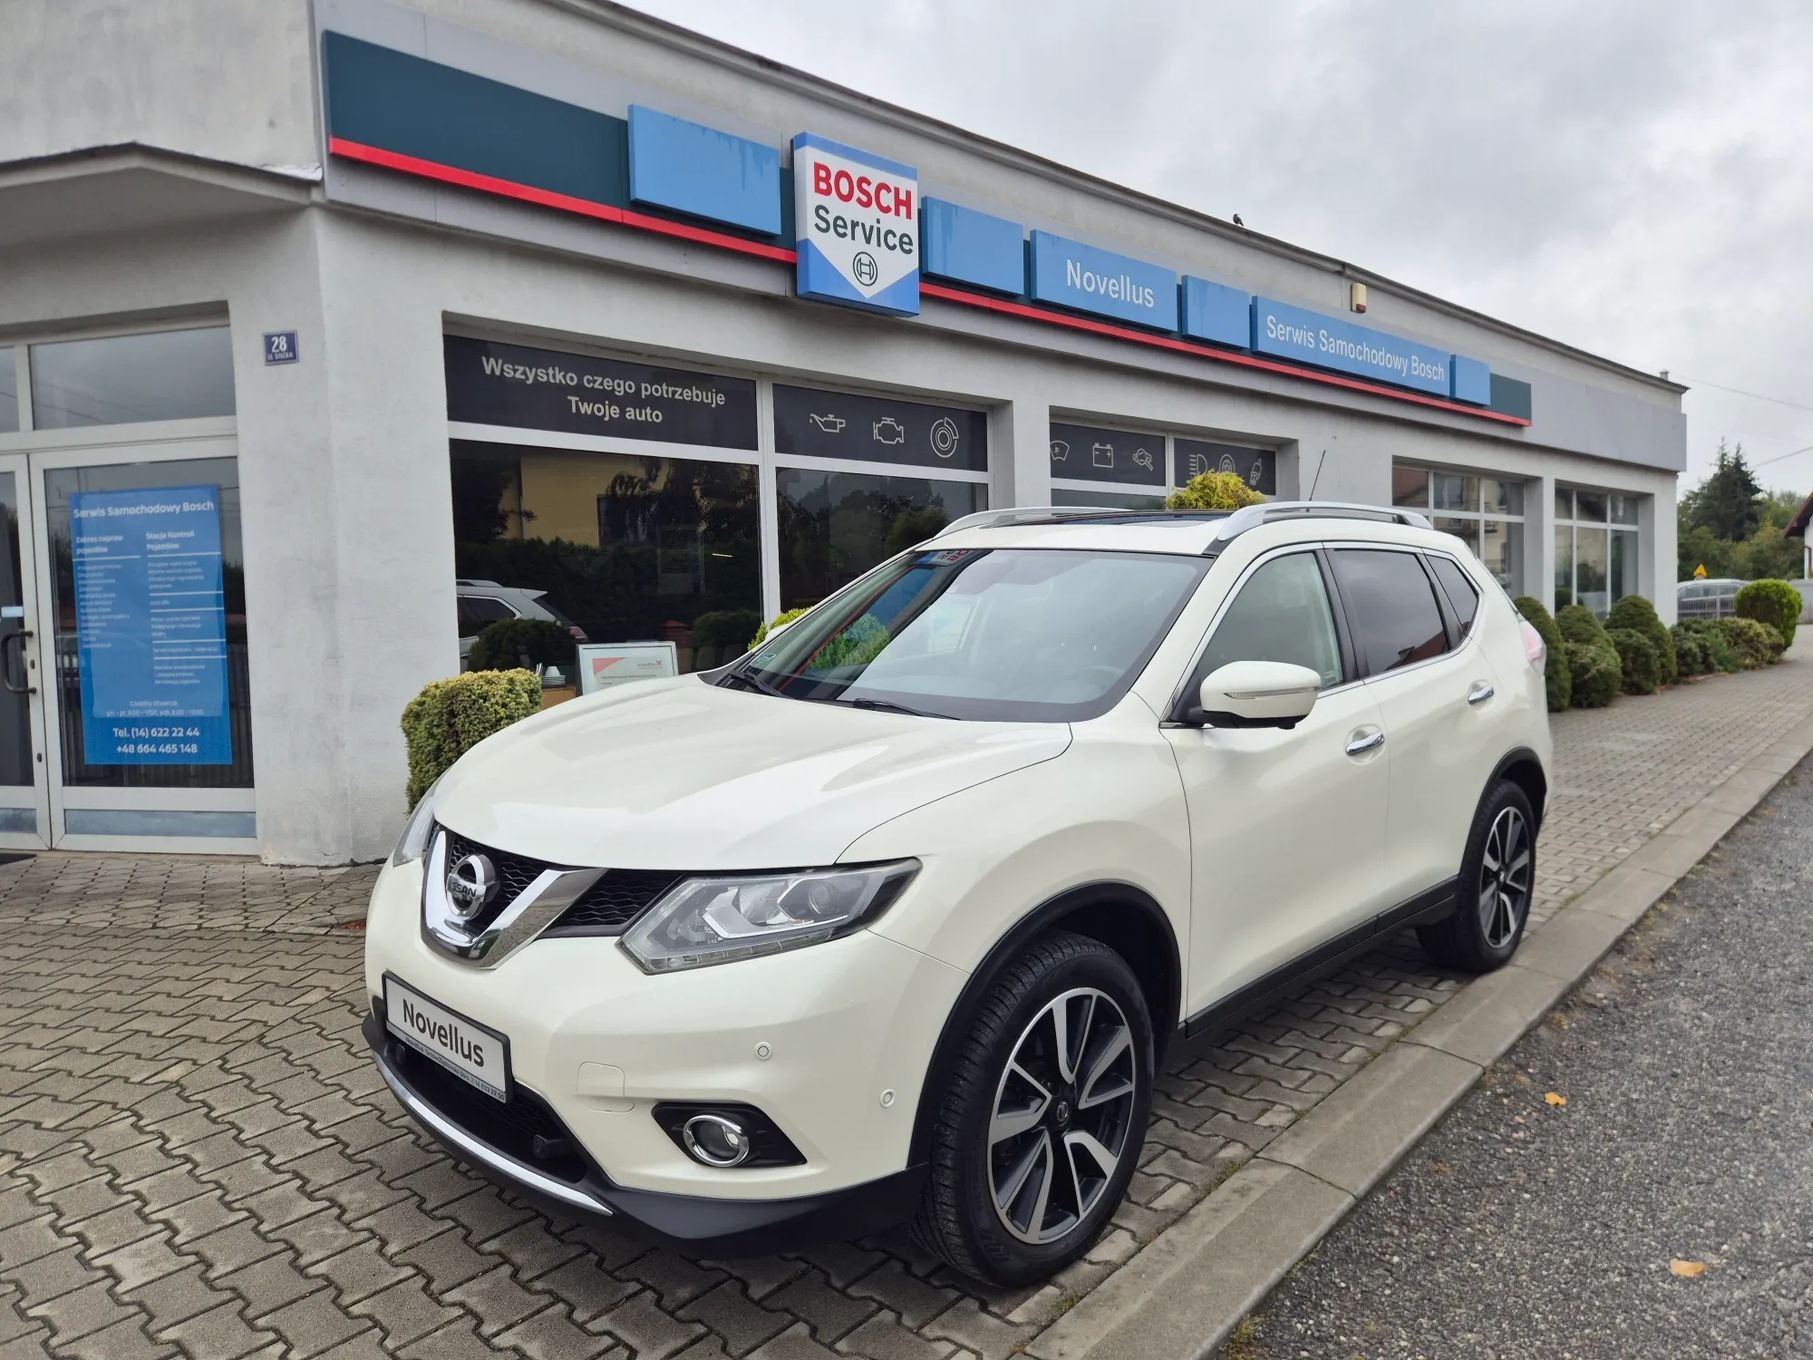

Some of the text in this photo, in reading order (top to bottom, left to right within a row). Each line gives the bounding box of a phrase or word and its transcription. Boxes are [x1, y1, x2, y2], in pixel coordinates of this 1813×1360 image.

[813, 161, 913, 220] BOSCH
[814, 204, 914, 255] Service
[1066, 258, 1155, 308] Novellus
[271, 335, 287, 353] 28
[1266, 314, 1445, 382] Serwis Samochodowy Bosch
[481, 356, 726, 408] Wszystko czego potrzebuje
[567, 395, 663, 423] Twoje auto
[73, 500, 214, 519] Serwis Samochodowy Bosch
[112, 727, 200, 739] Tel. (14) 622 22 44
[116, 743, 198, 754] +48 664 465 148
[402, 998, 485, 1067] Novellus
